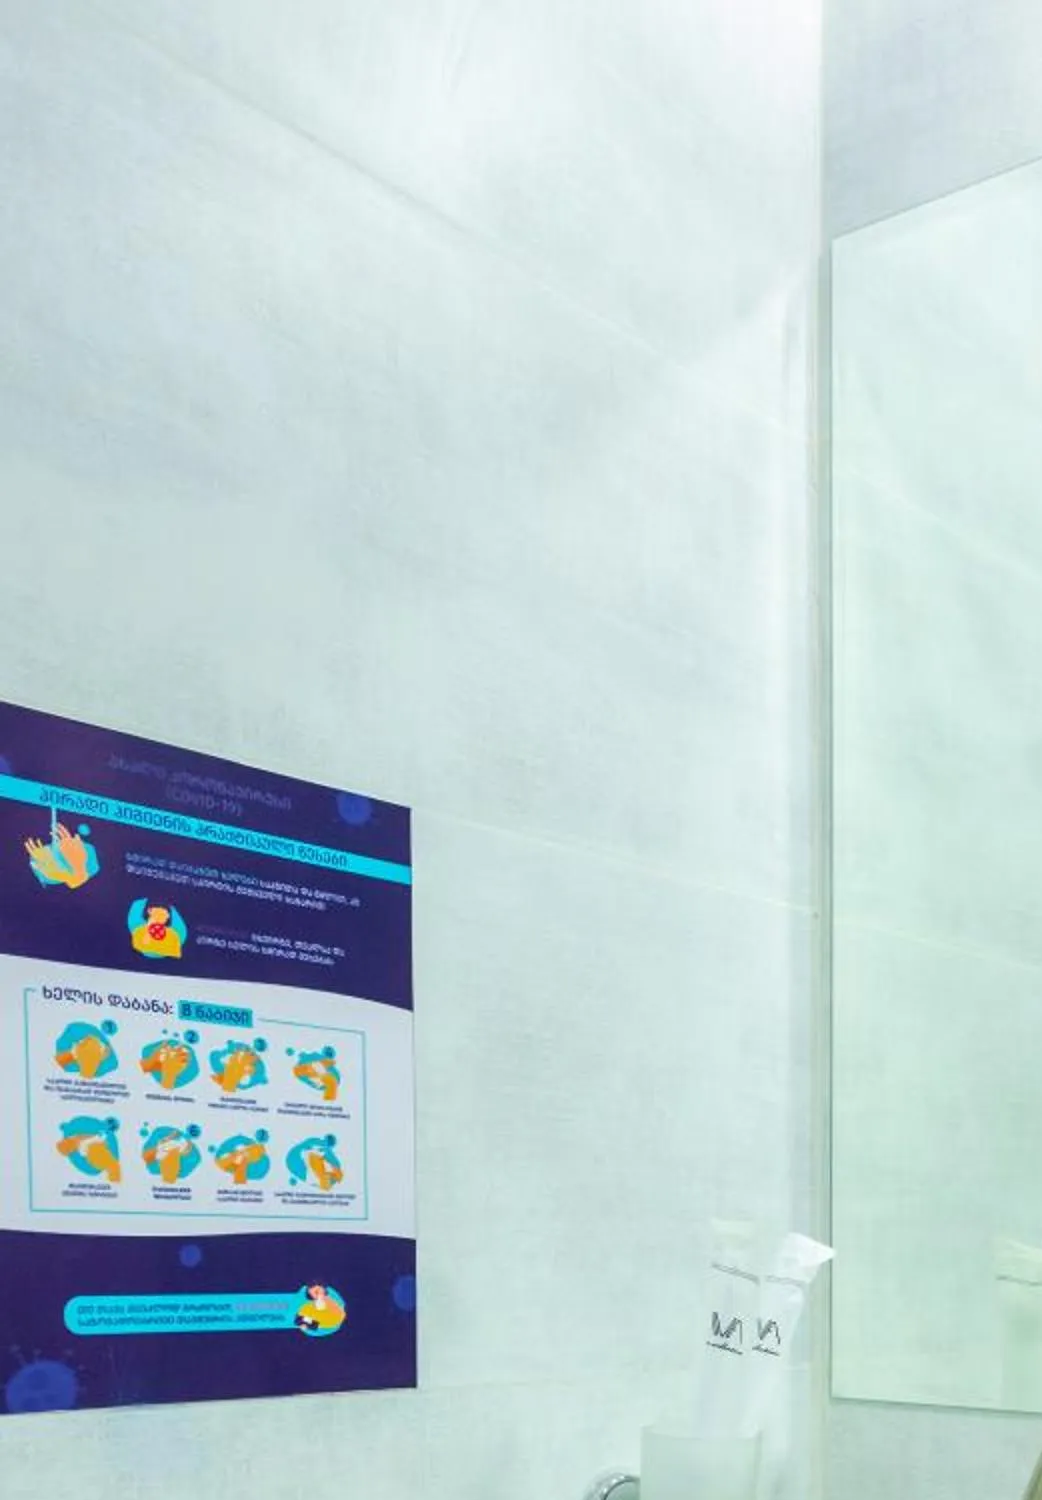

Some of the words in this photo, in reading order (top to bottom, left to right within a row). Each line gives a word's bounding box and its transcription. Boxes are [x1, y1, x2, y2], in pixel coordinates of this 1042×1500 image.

[40, 788, 109, 814] პირადი
[114, 805, 191, 832] ჰიგიენის
[298, 846, 347, 868] წესები
[42, 986, 103, 1005] ხელის
[108, 993, 173, 1014] დაბანა:
[195, 1005, 249, 1025] ნაბიჯი
